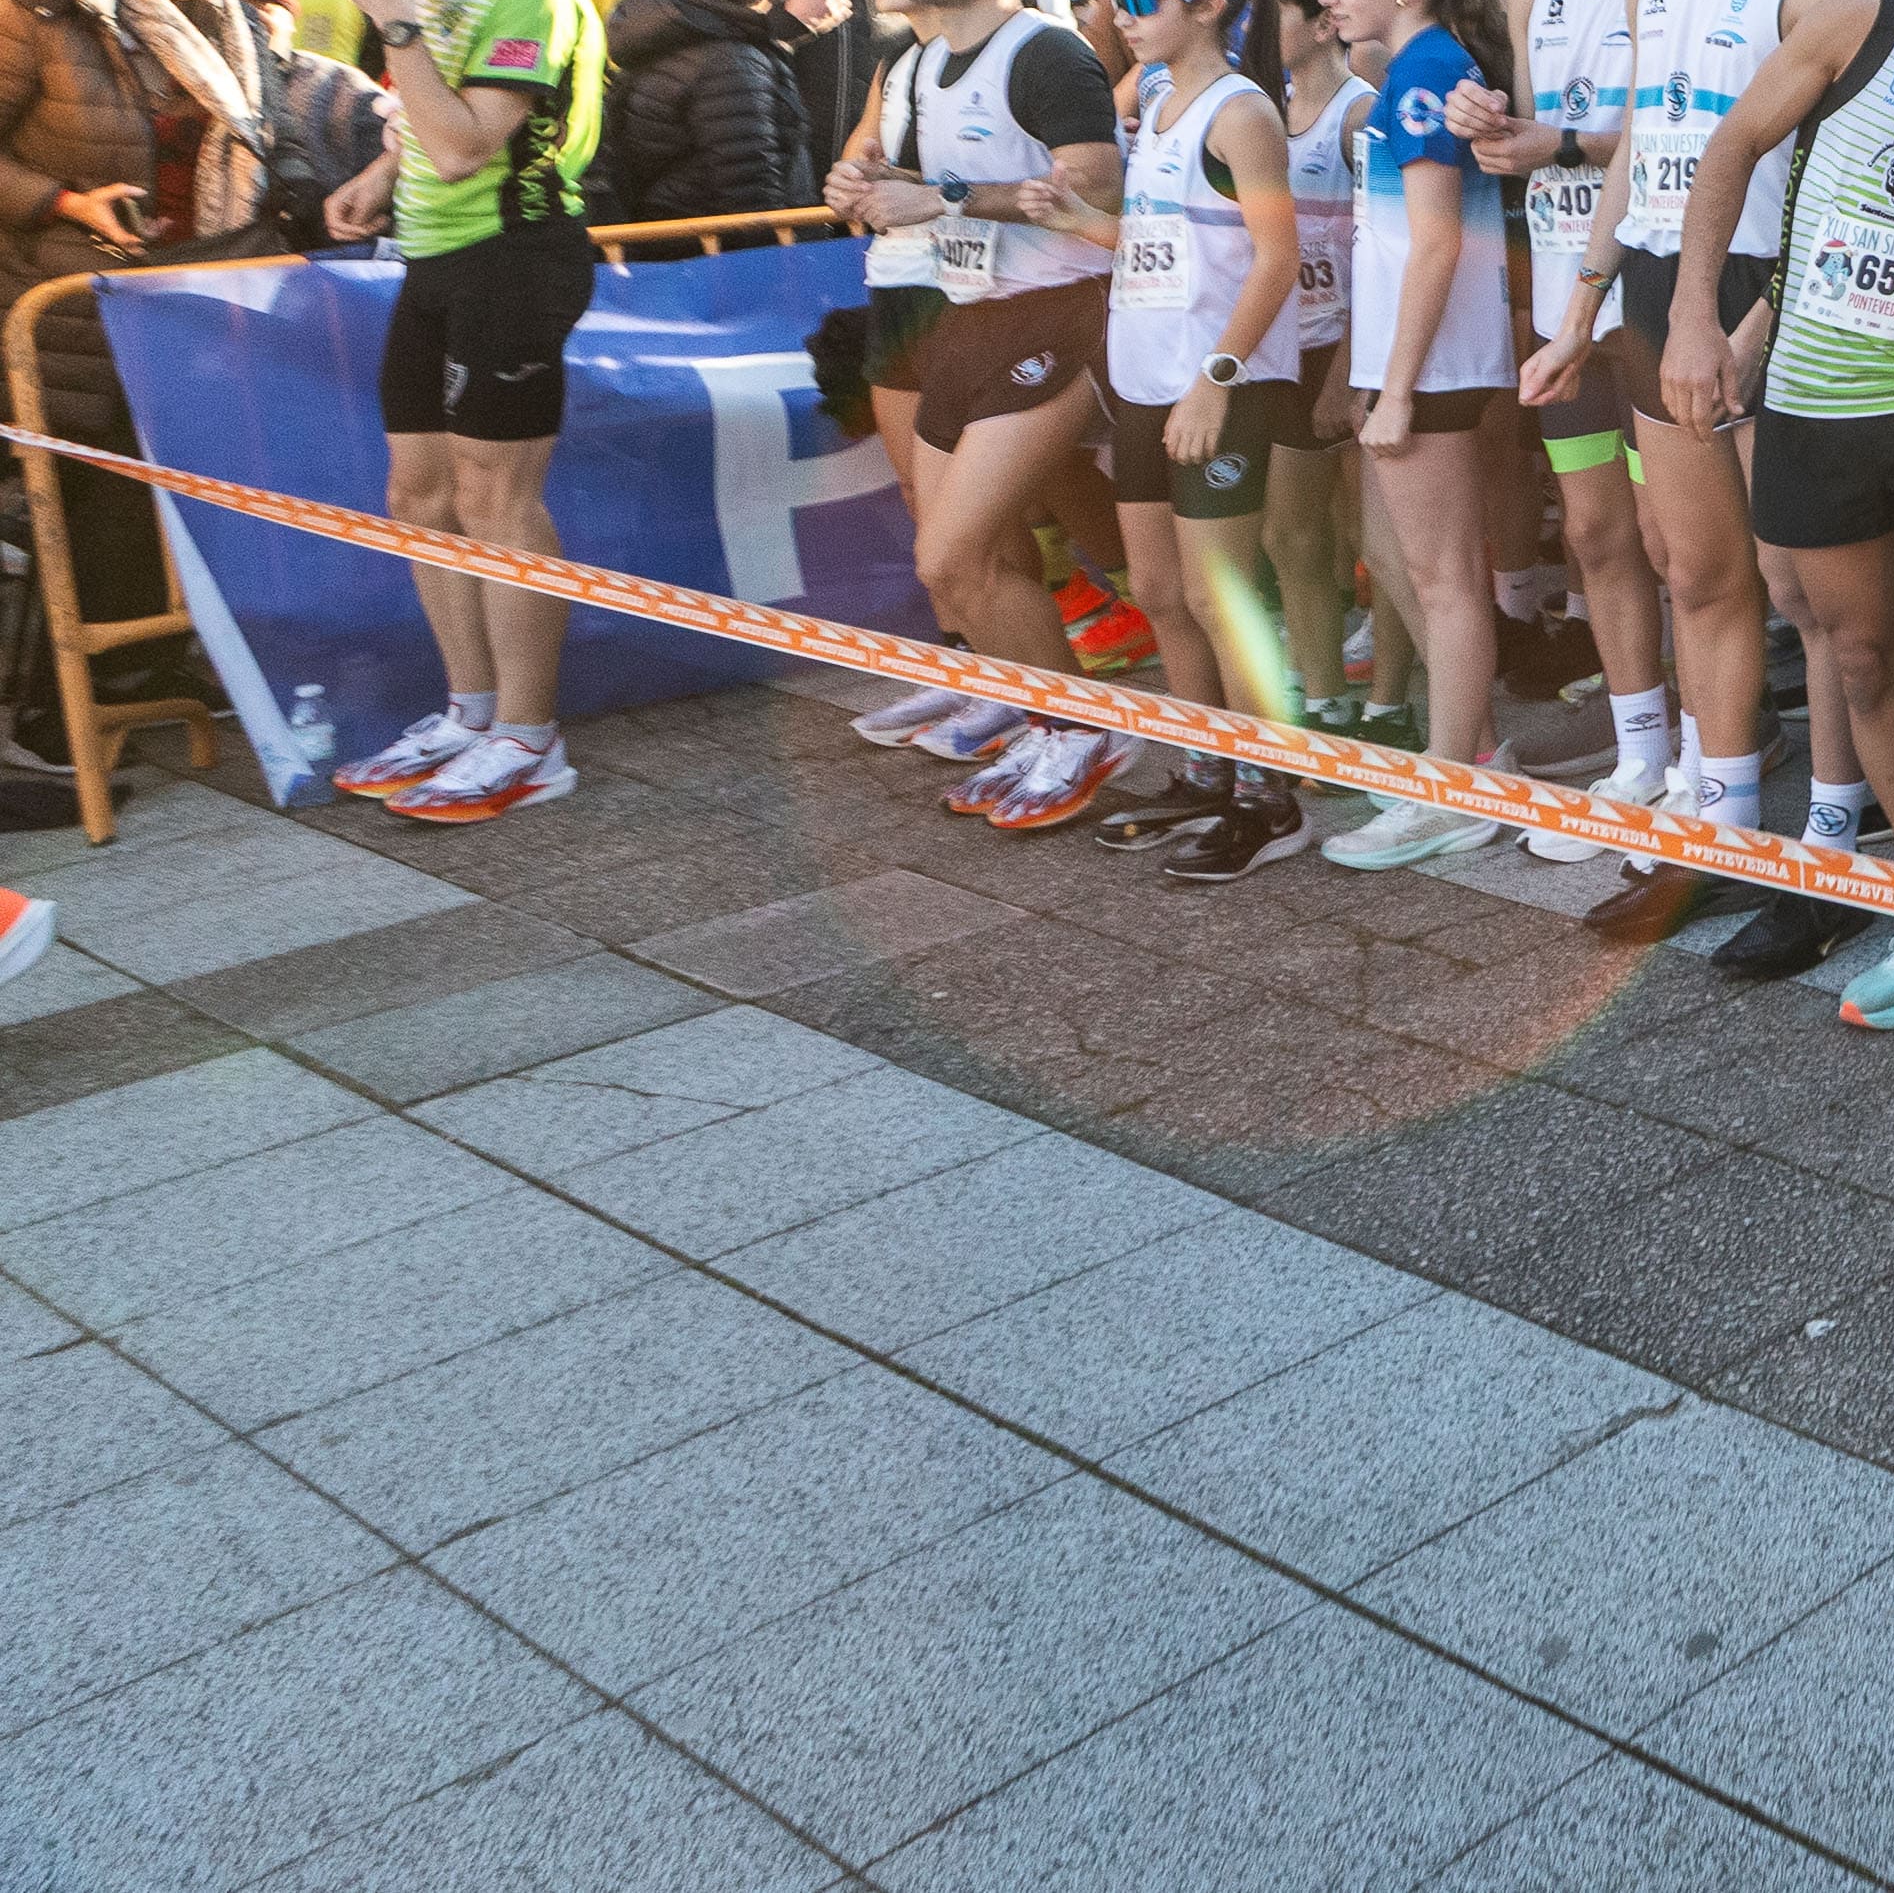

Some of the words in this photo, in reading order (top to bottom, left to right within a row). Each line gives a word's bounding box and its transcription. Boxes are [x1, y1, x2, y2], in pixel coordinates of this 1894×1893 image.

[1823, 216, 1848, 241] XLII
[1852, 226, 1880, 252] SAN
[943, 238, 985, 270] 4072
